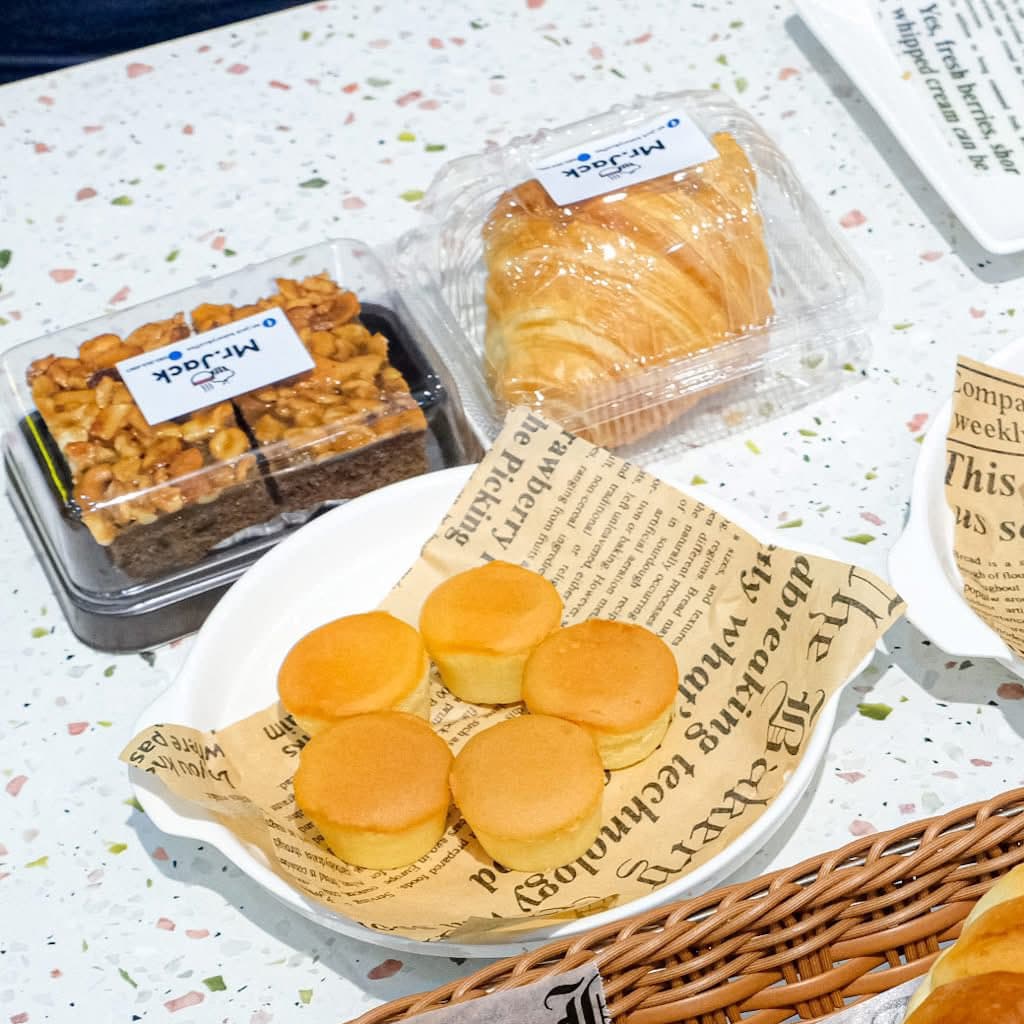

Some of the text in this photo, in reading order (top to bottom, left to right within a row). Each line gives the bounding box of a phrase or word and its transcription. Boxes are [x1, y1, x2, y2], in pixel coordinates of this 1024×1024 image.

[893, 8, 988, 170] whipped cream can be
[920, 4, 940, 36] Yes,
[936, 40, 968, 79] fresh
[957, 83, 995, 140] berries,
[562, 140, 665, 178] Mr.Jack
[152, 339, 259, 383] Mr.Jack
[445, 440, 525, 546] Picking
[544, 507, 564, 531] from
[630, 538, 667, 588] sourdough
[663, 524, 692, 570] naturally
[679, 533, 707, 578] different
[702, 584, 717, 605] and
